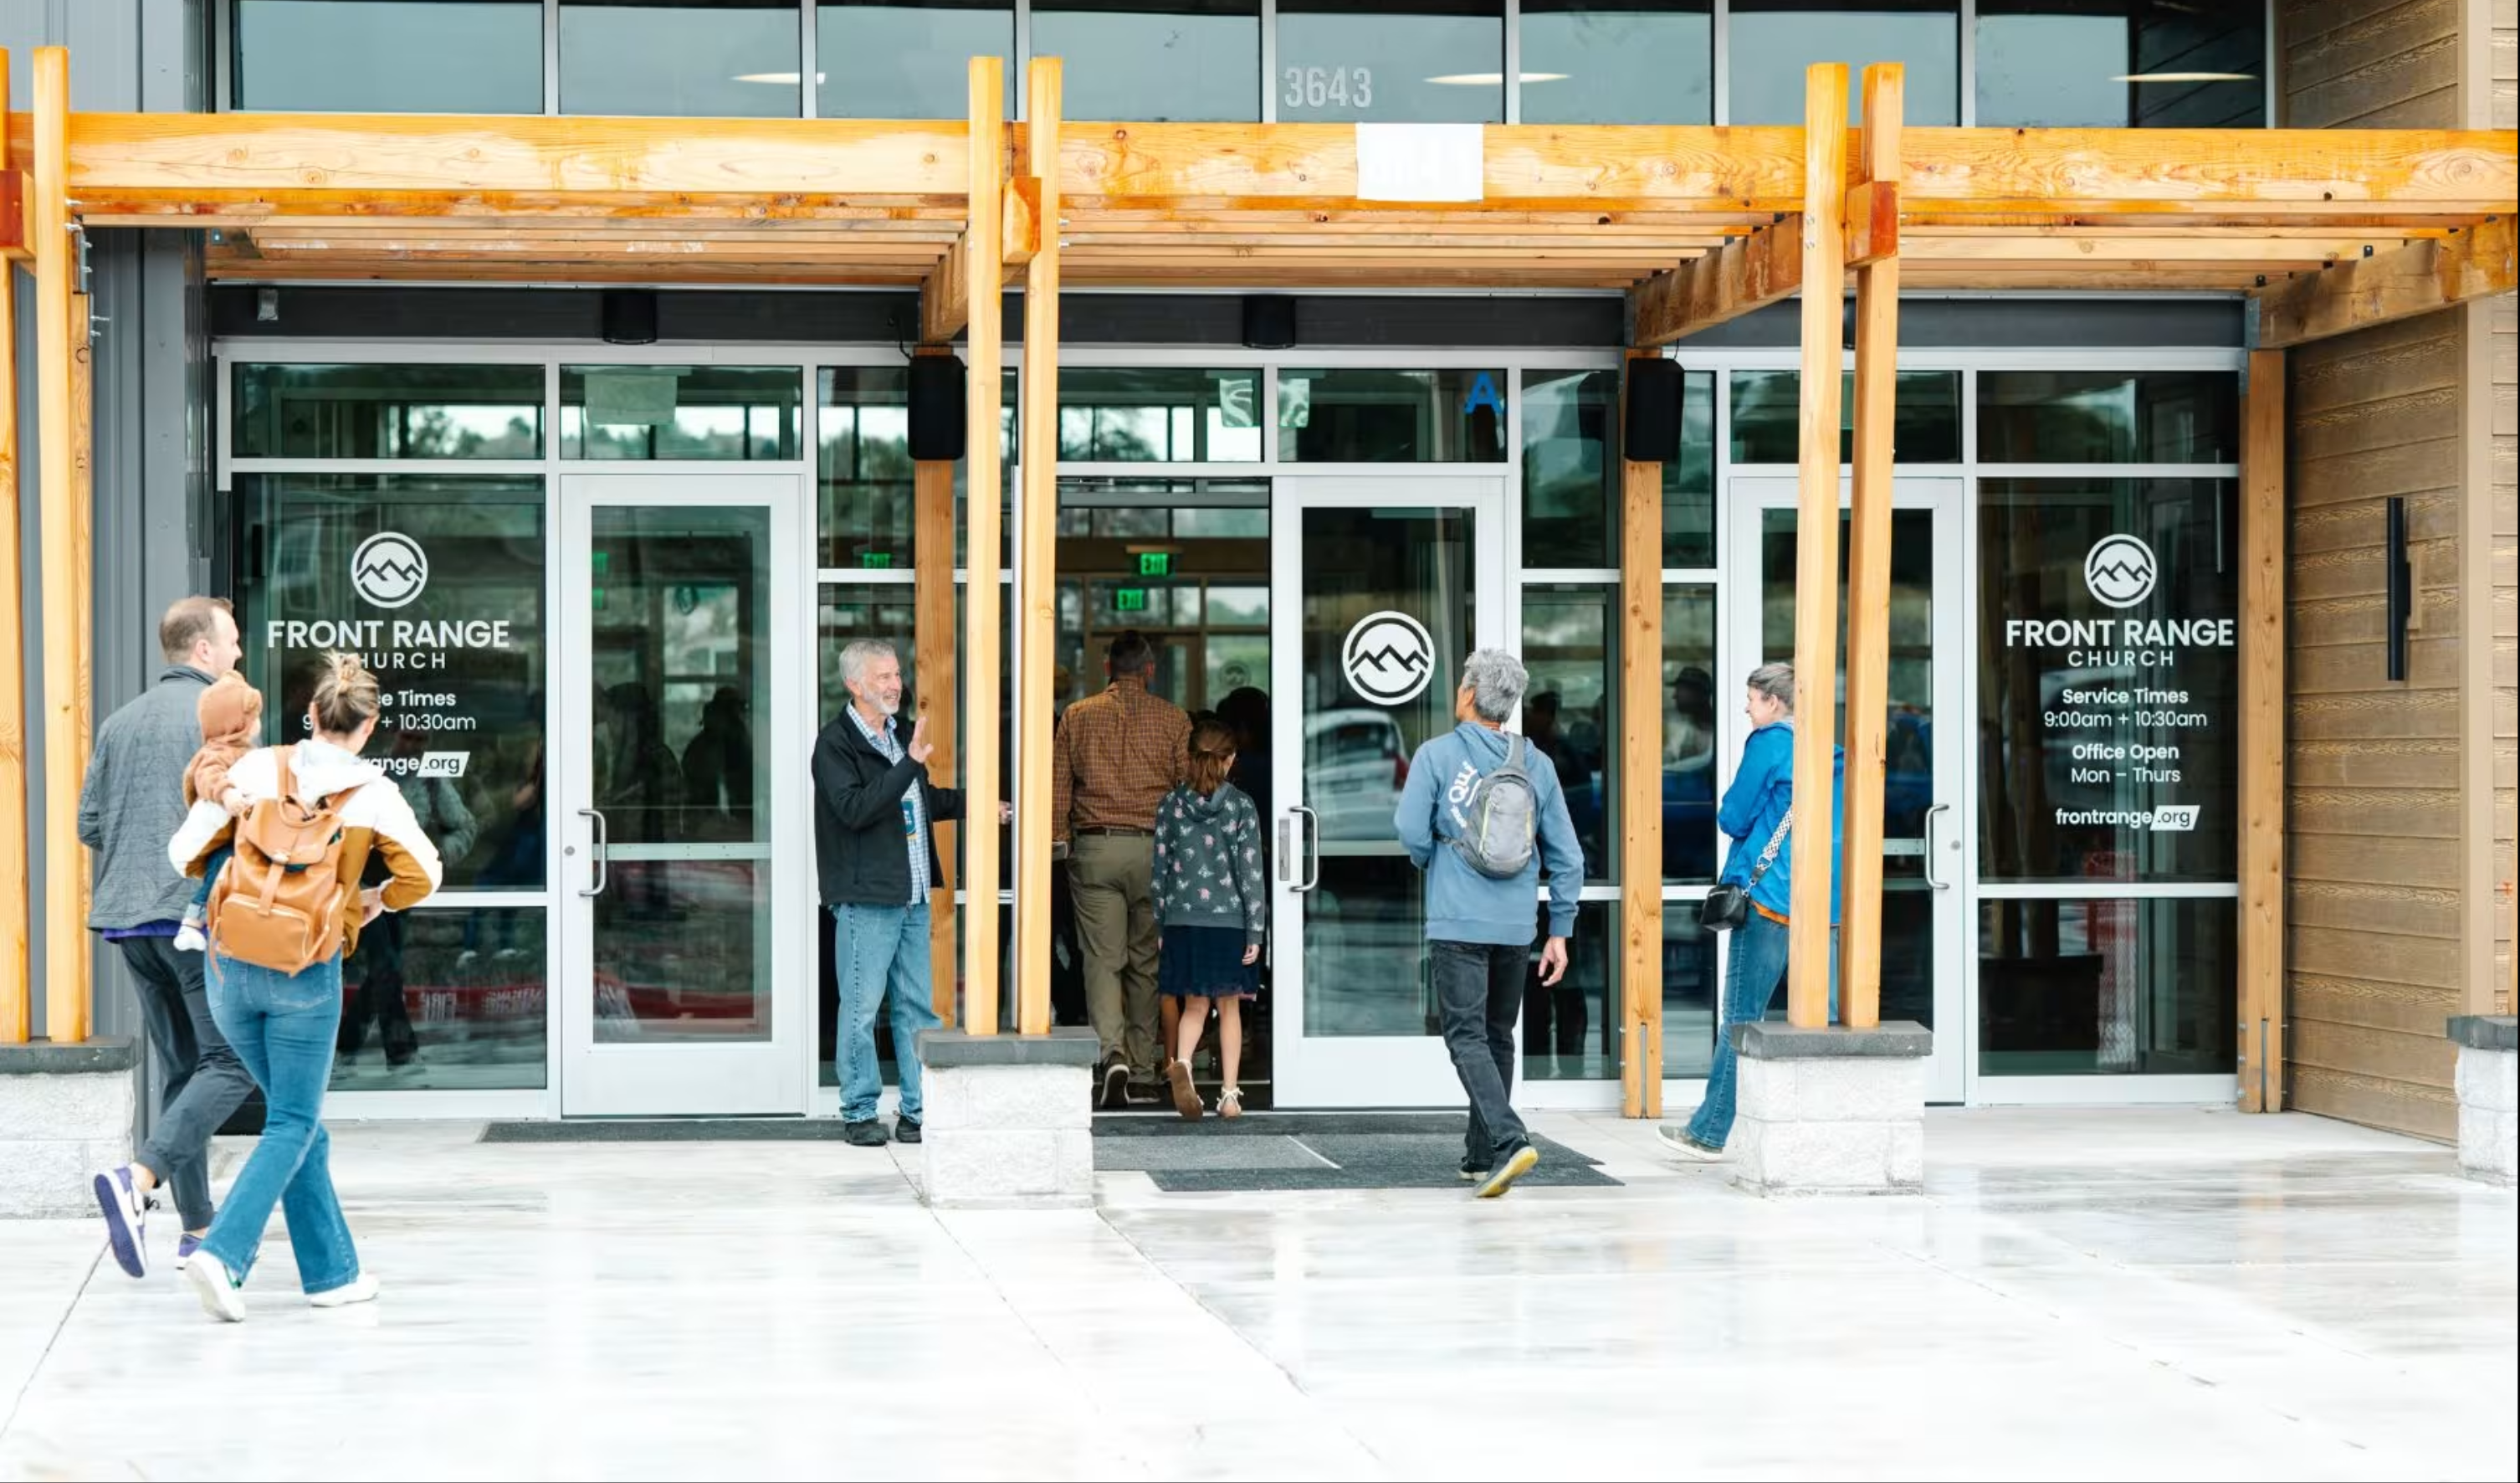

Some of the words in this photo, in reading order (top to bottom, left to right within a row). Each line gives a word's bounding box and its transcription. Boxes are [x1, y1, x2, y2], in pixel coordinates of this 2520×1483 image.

[1284, 66, 1372, 108] 3643
[267, 620, 384, 648] FRONT
[392, 620, 510, 648] RANGE
[2006, 619, 2116, 647] FRONT
[2124, 618, 2234, 646] RANGE
[358, 652, 446, 669] HURCH
[2068, 650, 2174, 667] CHURCH
[398, 690, 457, 706] Times
[2062, 688, 2129, 704] Service
[2133, 687, 2189, 704] Times
[381, 716, 392, 728] +
[399, 714, 476, 731] 10:30am
[2044, 711, 2113, 727] 9:00am
[2118, 714, 2129, 726] +
[2135, 711, 2207, 726] 10:30am
[2072, 743, 2126, 760] Office
[2130, 744, 2179, 763] Open
[2071, 767, 2110, 783] Mon
[2133, 767, 2181, 783] Thurs
[2056, 808, 2191, 828] frontrange.org
